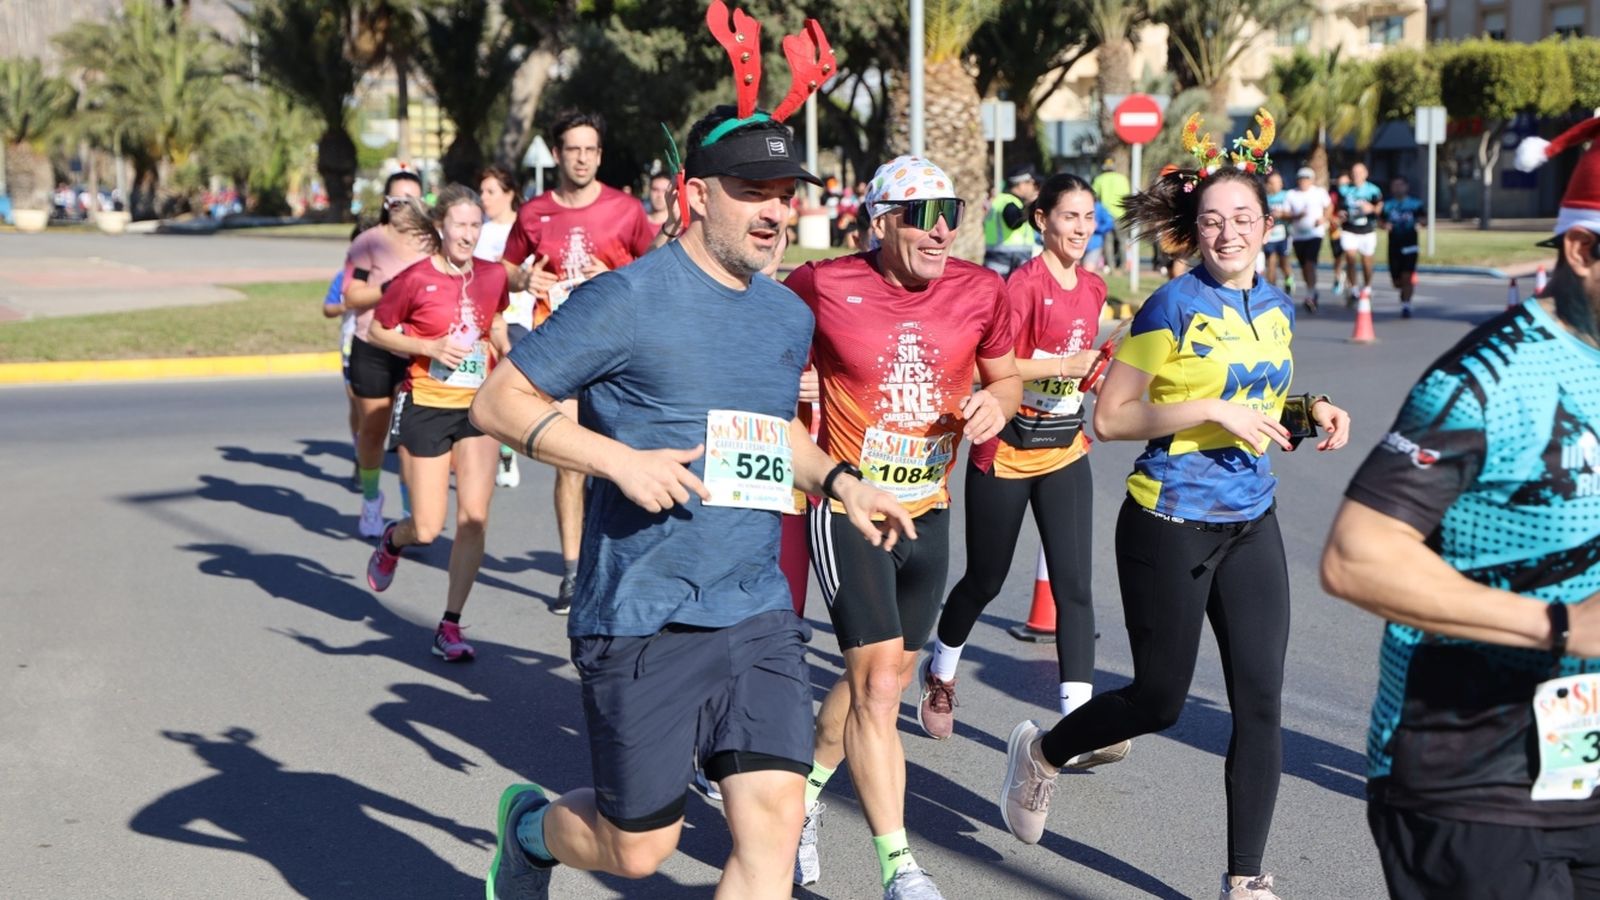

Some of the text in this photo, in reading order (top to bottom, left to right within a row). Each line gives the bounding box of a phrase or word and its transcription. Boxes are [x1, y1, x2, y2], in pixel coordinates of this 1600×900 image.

[898, 333, 917, 344] SAN
[898, 345, 922, 363] SIL
[893, 363, 926, 383] VES
[1041, 379, 1074, 395] 1378
[886, 382, 935, 413] TRE
[711, 424, 730, 439] SAN
[866, 438, 883, 451] SAN
[736, 453, 784, 483] 526
[879, 464, 934, 483] 1084
[1581, 730, 1600, 763] 3
